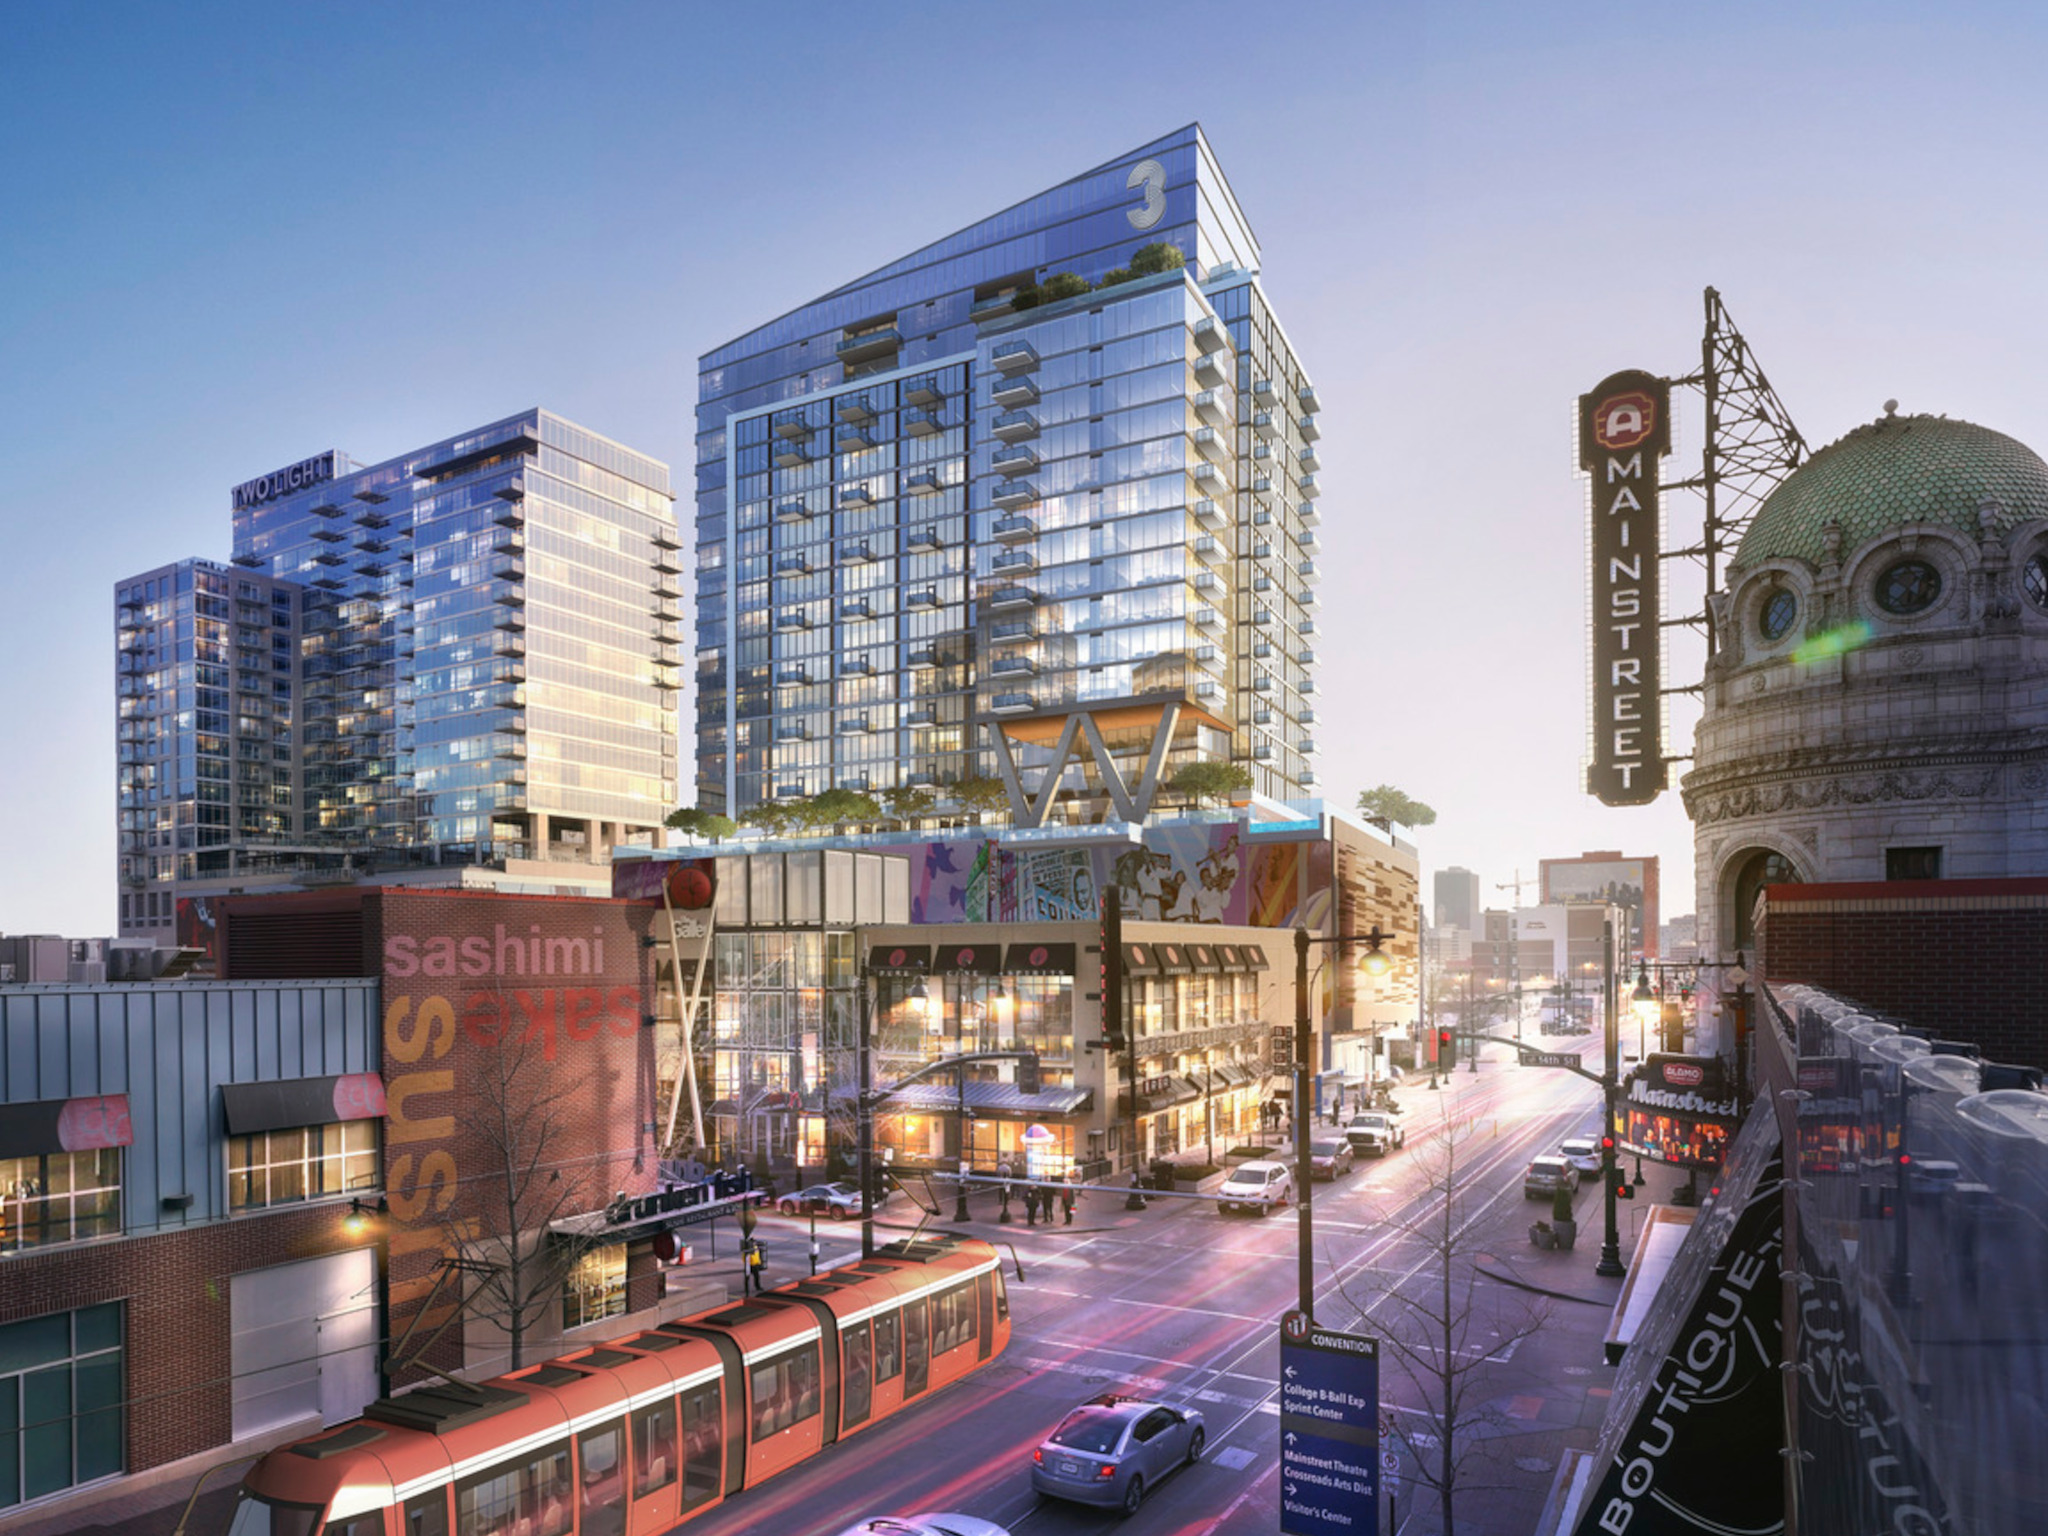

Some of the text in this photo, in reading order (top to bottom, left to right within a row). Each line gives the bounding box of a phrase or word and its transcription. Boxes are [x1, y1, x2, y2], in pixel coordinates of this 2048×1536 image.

[1126, 159, 1167, 230] 3
[232, 453, 327, 508] TWO LIGHT
[1607, 452, 1642, 790] MAINSTREET
[384, 924, 604, 977] sashimi
[462, 985, 643, 1062] sake
[1666, 1066, 1699, 1079] ALAMO
[1627, 1079, 1738, 1117] Mainstreet
[385, 995, 480, 1341] sushi
[1311, 1334, 1373, 1354] CONVENTION
[1284, 1383, 1366, 1409] College B-Ball Exp
[1284, 1399, 1343, 1420] Sprint Center
[1598, 1250, 1766, 1535] BOUTIQUE
[1284, 1450, 1368, 1478] Mainstreet Theatre
[1284, 1466, 1333, 1487] Crossroads
[1334, 1476, 1352, 1491] Arts
[1354, 1481, 1373, 1496] Dist
[1284, 1500, 1352, 1526] Visitor's Center
